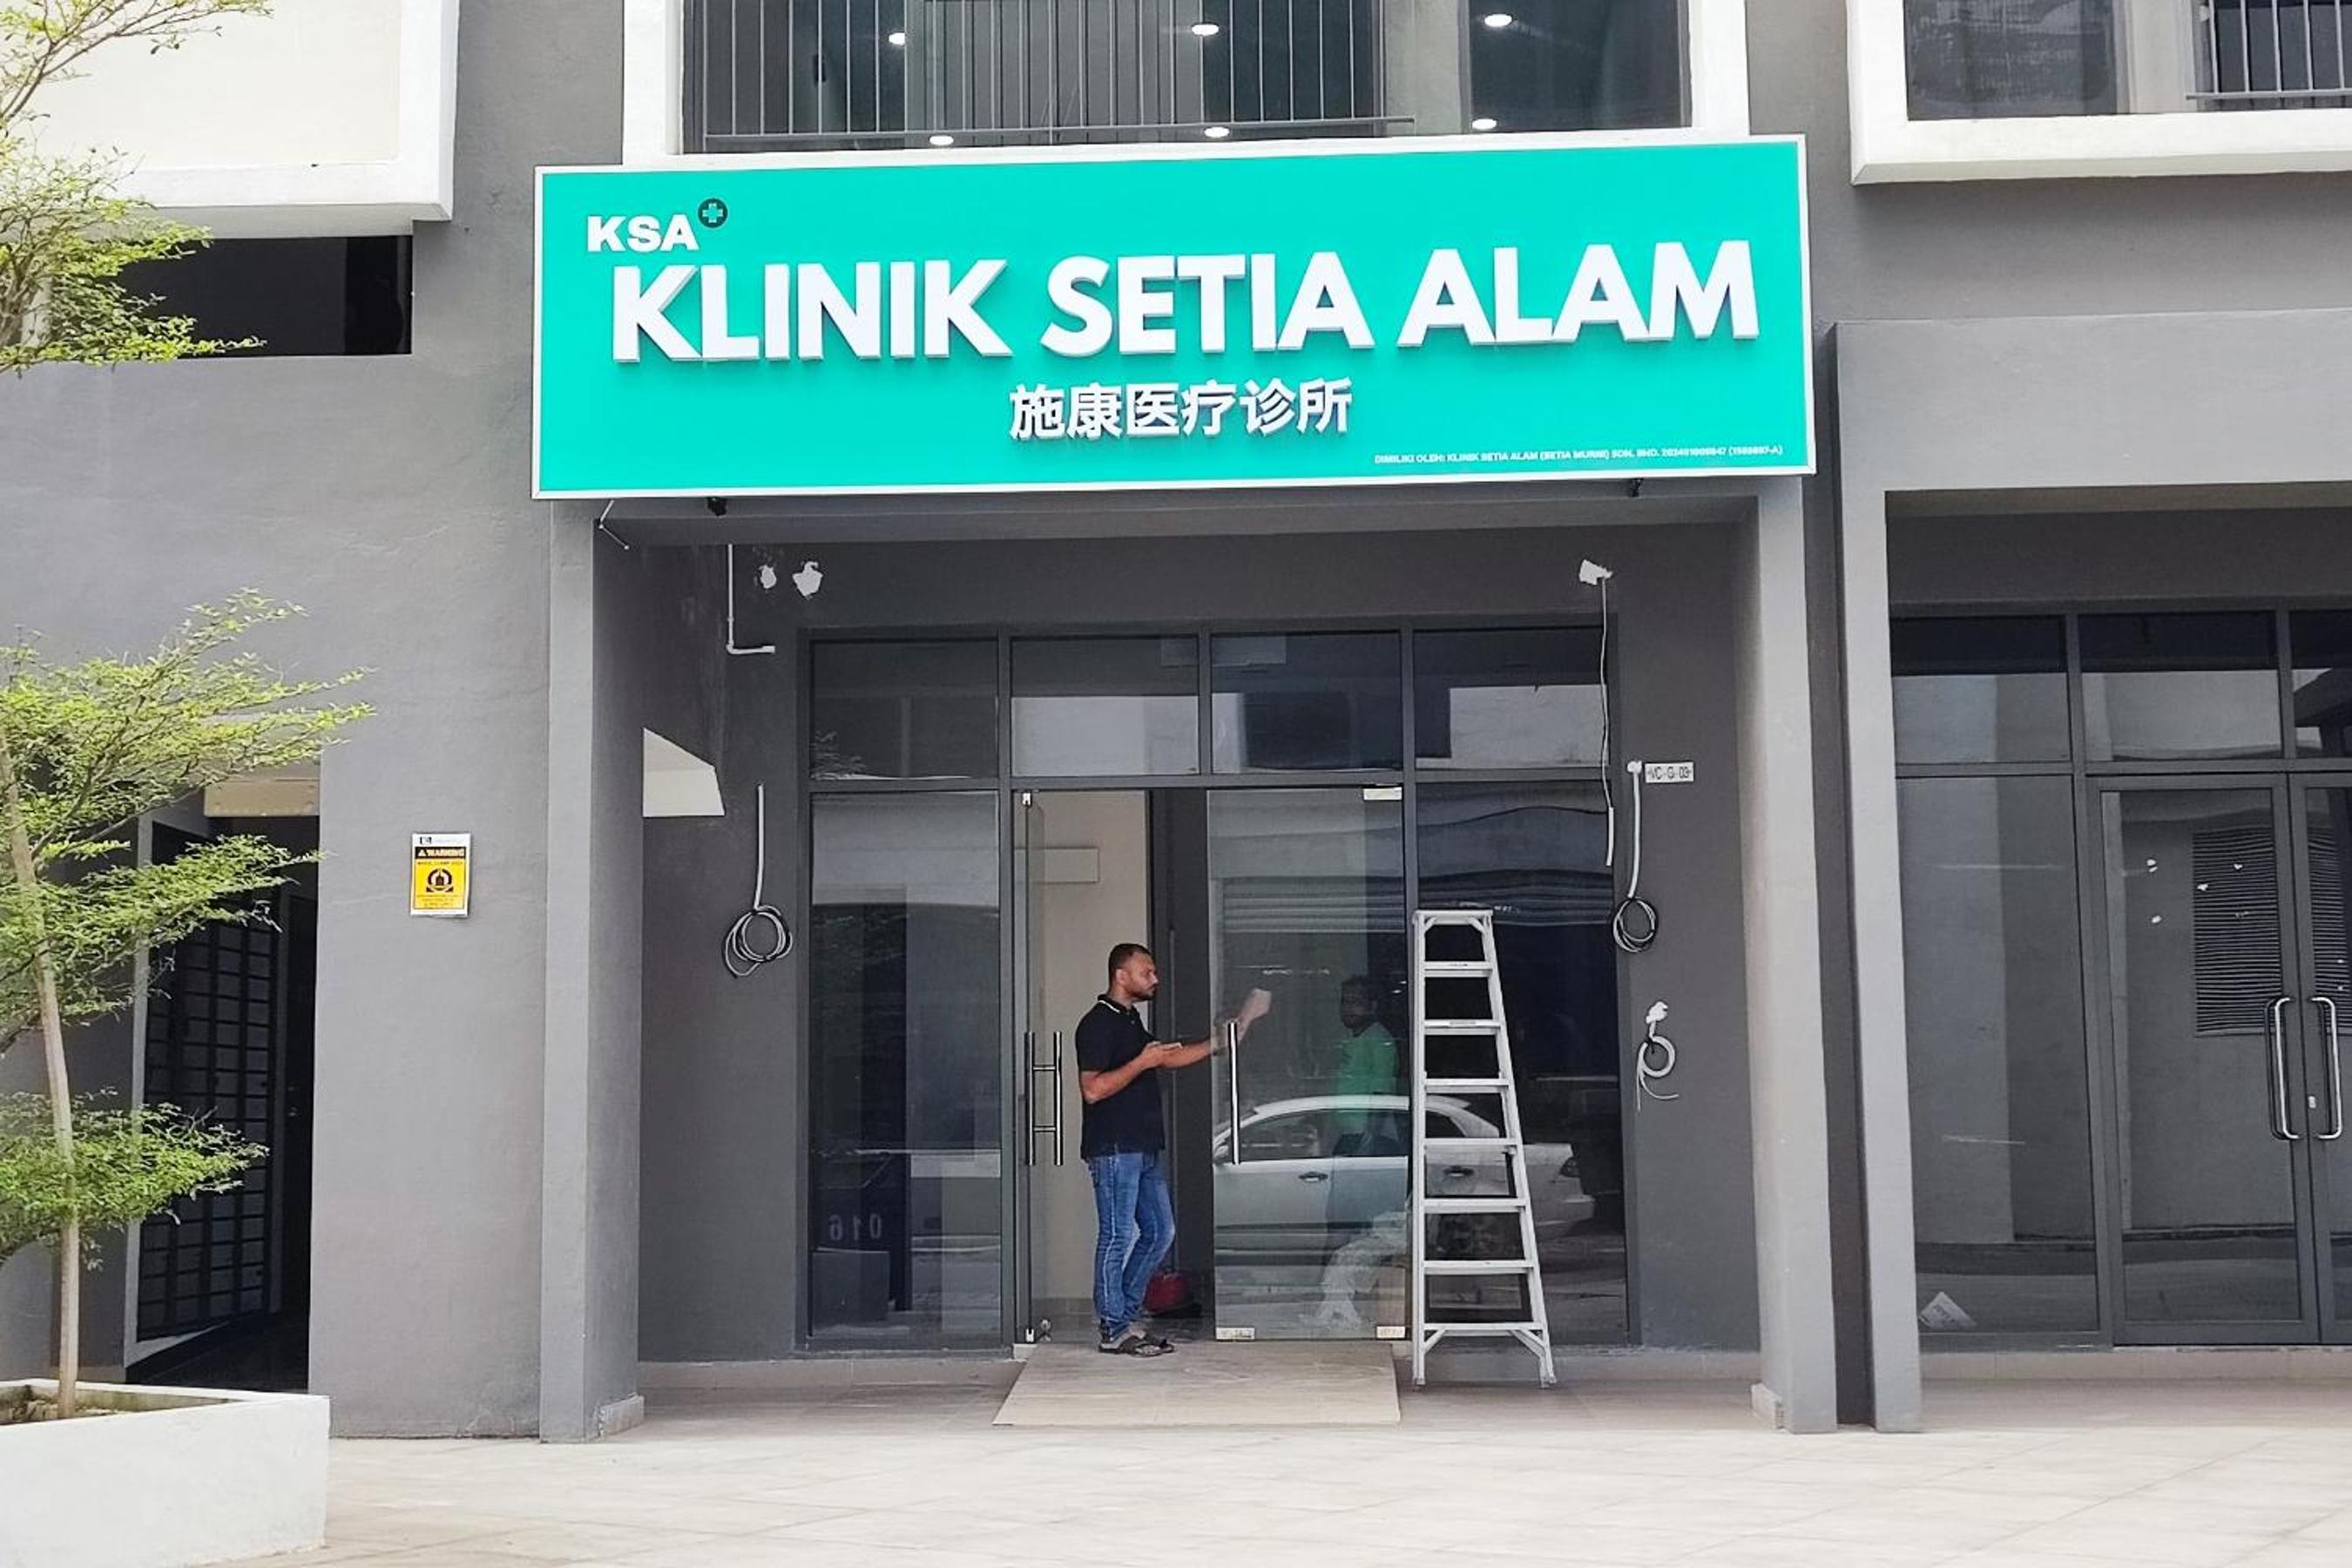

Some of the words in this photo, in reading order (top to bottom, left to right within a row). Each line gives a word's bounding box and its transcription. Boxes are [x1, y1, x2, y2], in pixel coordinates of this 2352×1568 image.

[587, 214, 700, 253] KSA
[613, 260, 1014, 362] KLINIK
[1040, 251, 1375, 357] SETIA
[1397, 240, 1760, 347] ALAM
[1010, 376, 1353, 439] 施康医疗诊所
[1446, 453, 1478, 463] KLINIK
[1480, 452, 1509, 462] SETIA
[1510, 451, 1538, 461] ALAM
